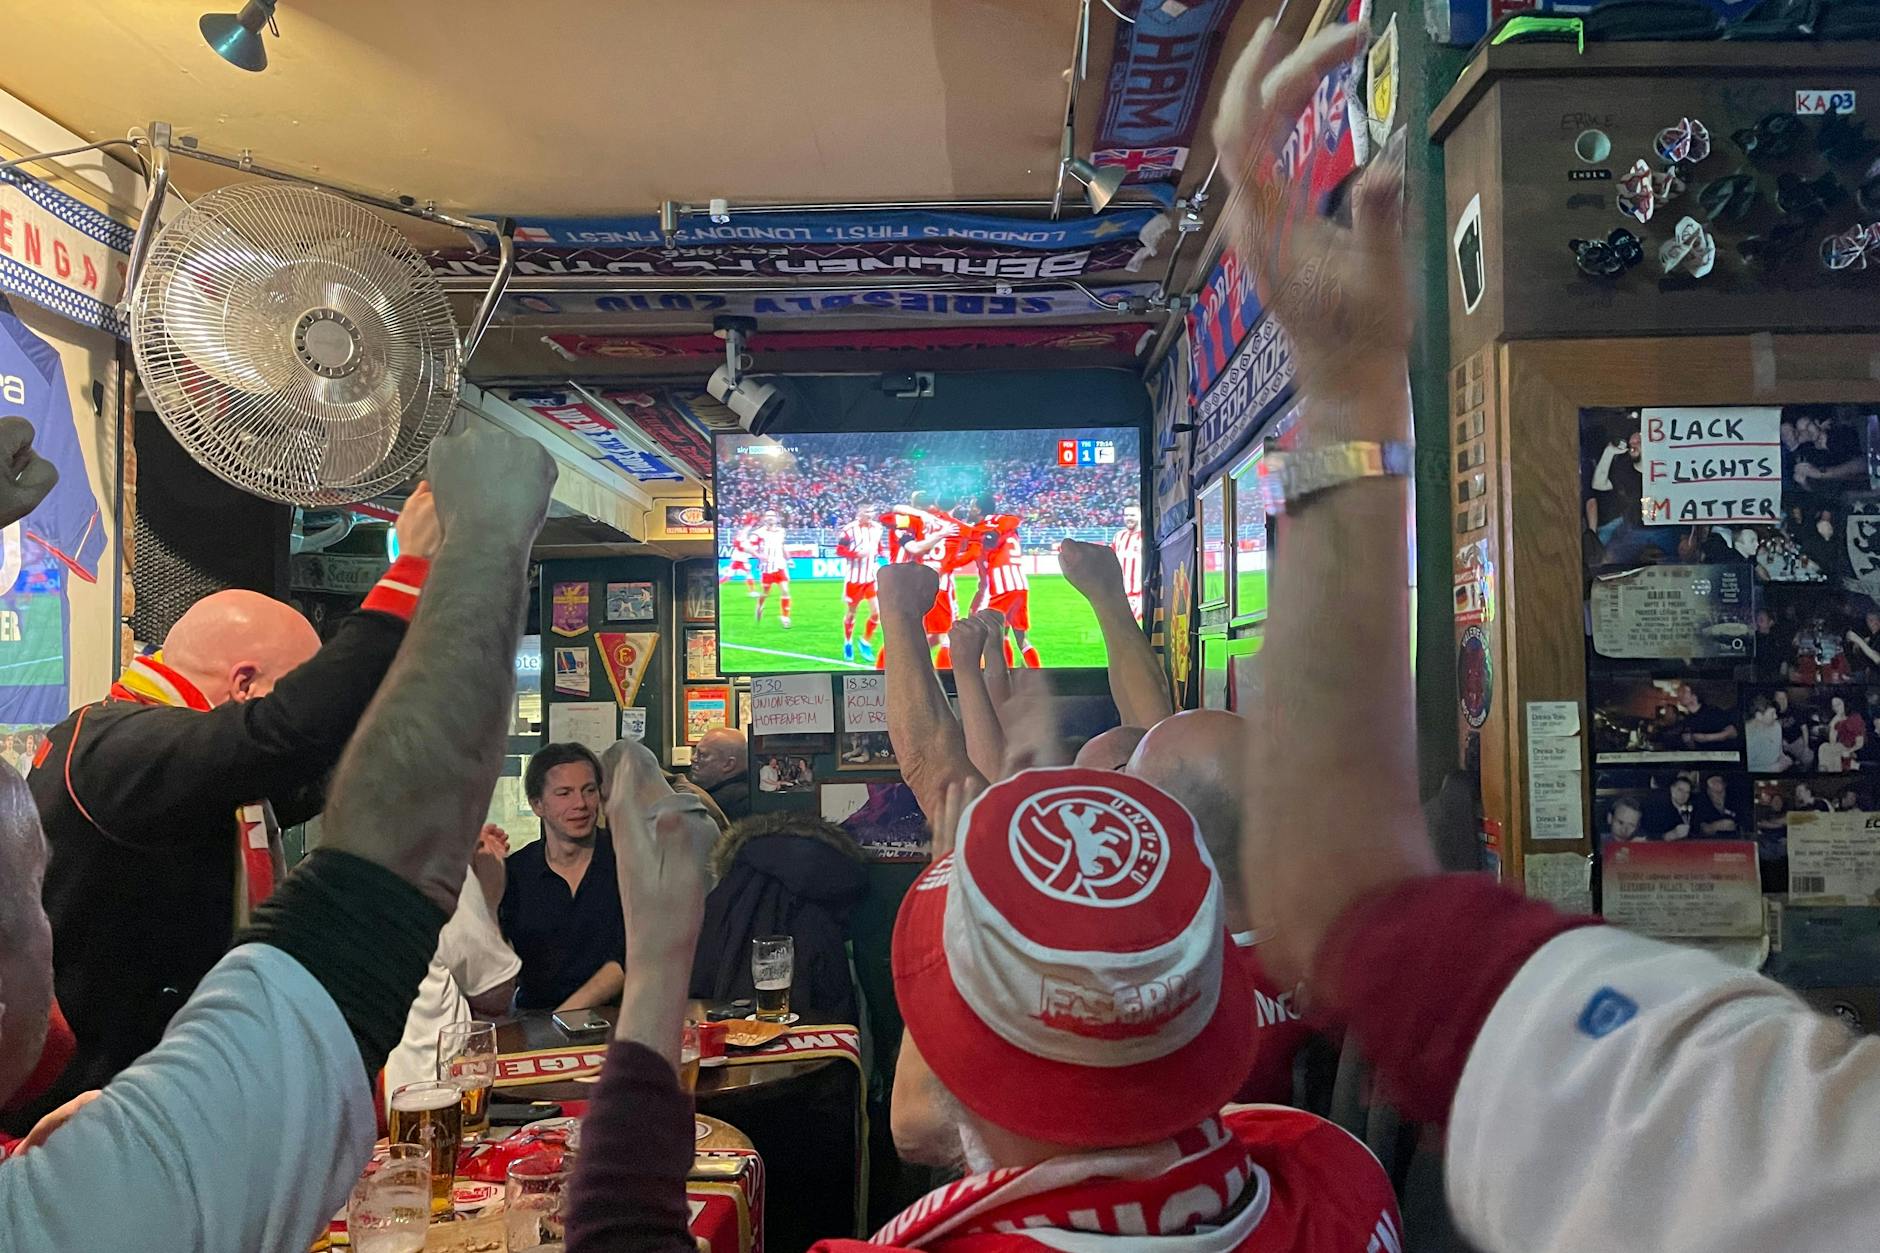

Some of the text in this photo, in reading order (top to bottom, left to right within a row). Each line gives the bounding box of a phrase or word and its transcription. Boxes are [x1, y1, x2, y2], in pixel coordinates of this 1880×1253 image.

[1117, 31, 1201, 129] HAM
[1797, 92, 1854, 112] KA 03
[565, 225, 1067, 243] LONDON'S FIRST, LONDON'S FINEST
[670, 260, 755, 274] FC
[783, 250, 1092, 279] BERLINER
[1218, 374, 1249, 436] FOR
[1648, 417, 1745, 443] BLACK
[1063, 449, 1092, 462] 0 1
[1651, 498, 1777, 522] MATTER
[812, 559, 848, 578] DK
[514, 655, 541, 670] ote
[752, 696, 784, 710] UNION
[753, 712, 818, 728] HOFFENHEIM
